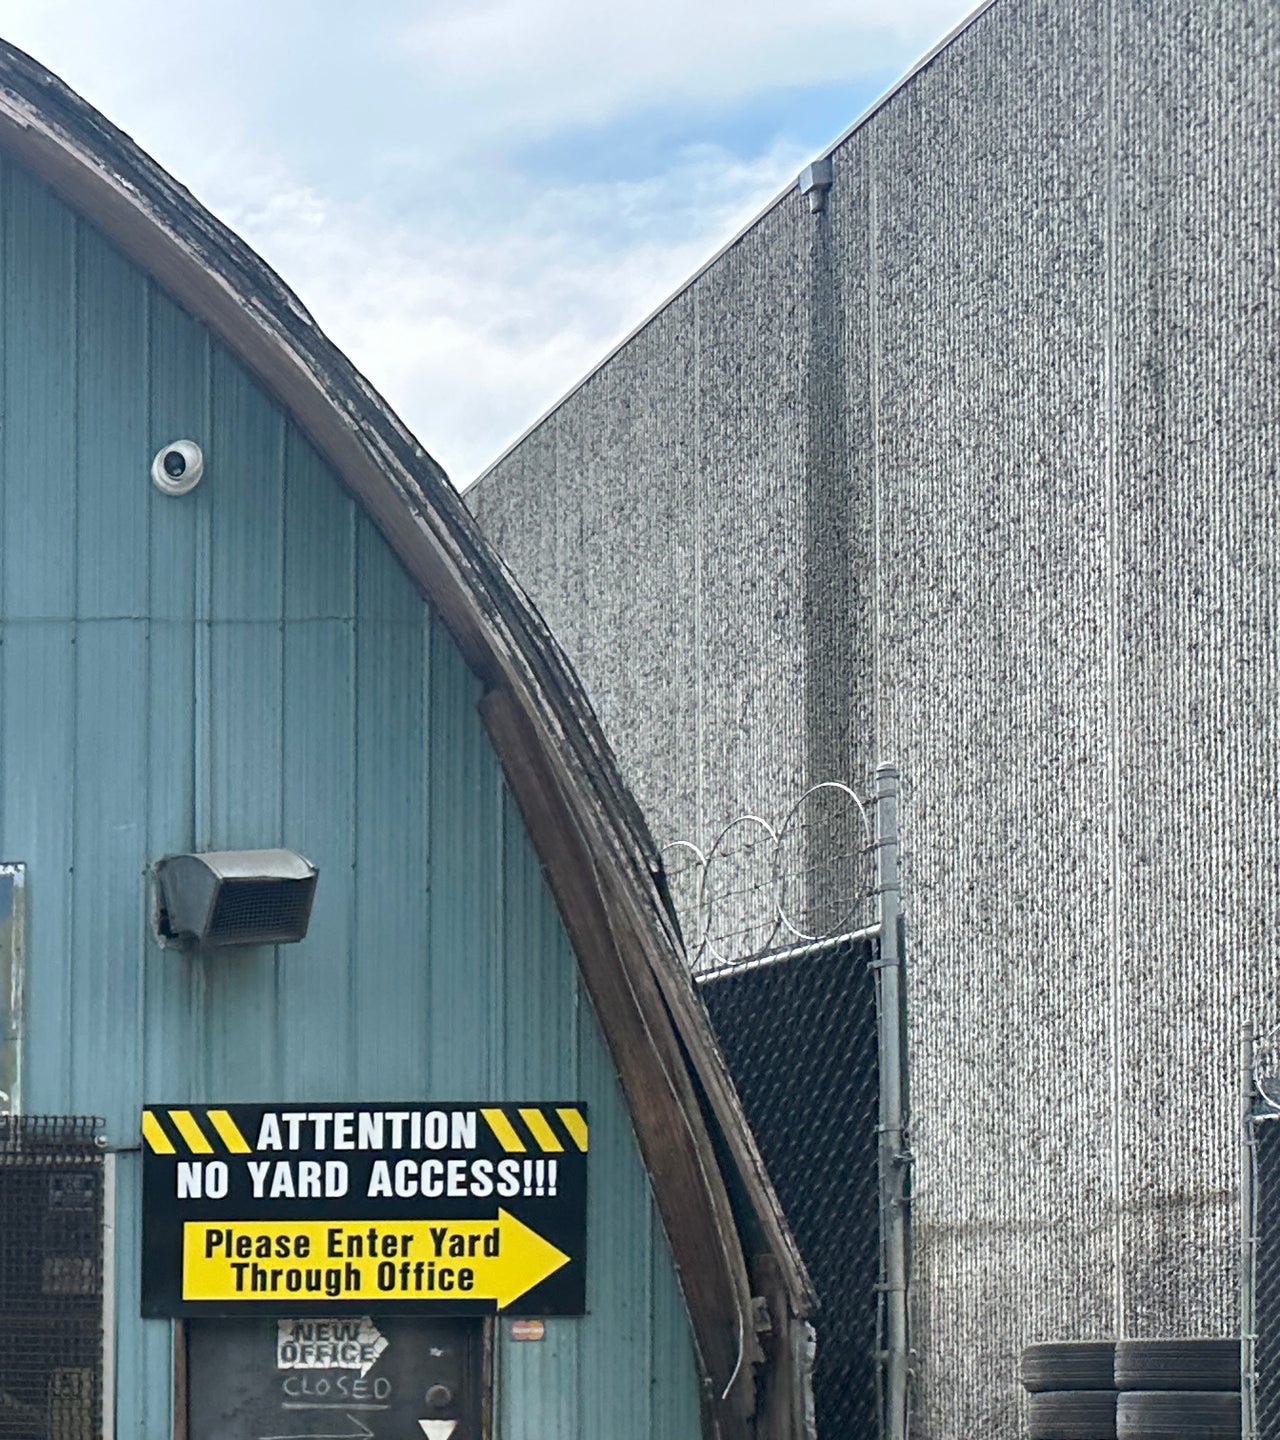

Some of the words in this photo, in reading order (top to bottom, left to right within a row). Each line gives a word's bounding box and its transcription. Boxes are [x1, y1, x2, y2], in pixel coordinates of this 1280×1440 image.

[256, 1110, 477, 1152] ATTENTION
[176, 1161, 229, 1199] NO
[247, 1160, 348, 1198] YARD
[367, 1159, 558, 1198] ACCESS!!!
[205, 1228, 310, 1259] Please
[327, 1228, 414, 1258] Enter
[428, 1227, 501, 1258] Yard
[230, 1262, 361, 1297] Through
[377, 1262, 475, 1292] Office
[290, 1322, 360, 1342] NEW
[280, 1341, 375, 1363] OFFICE
[282, 1375, 392, 1400] CLOSED
